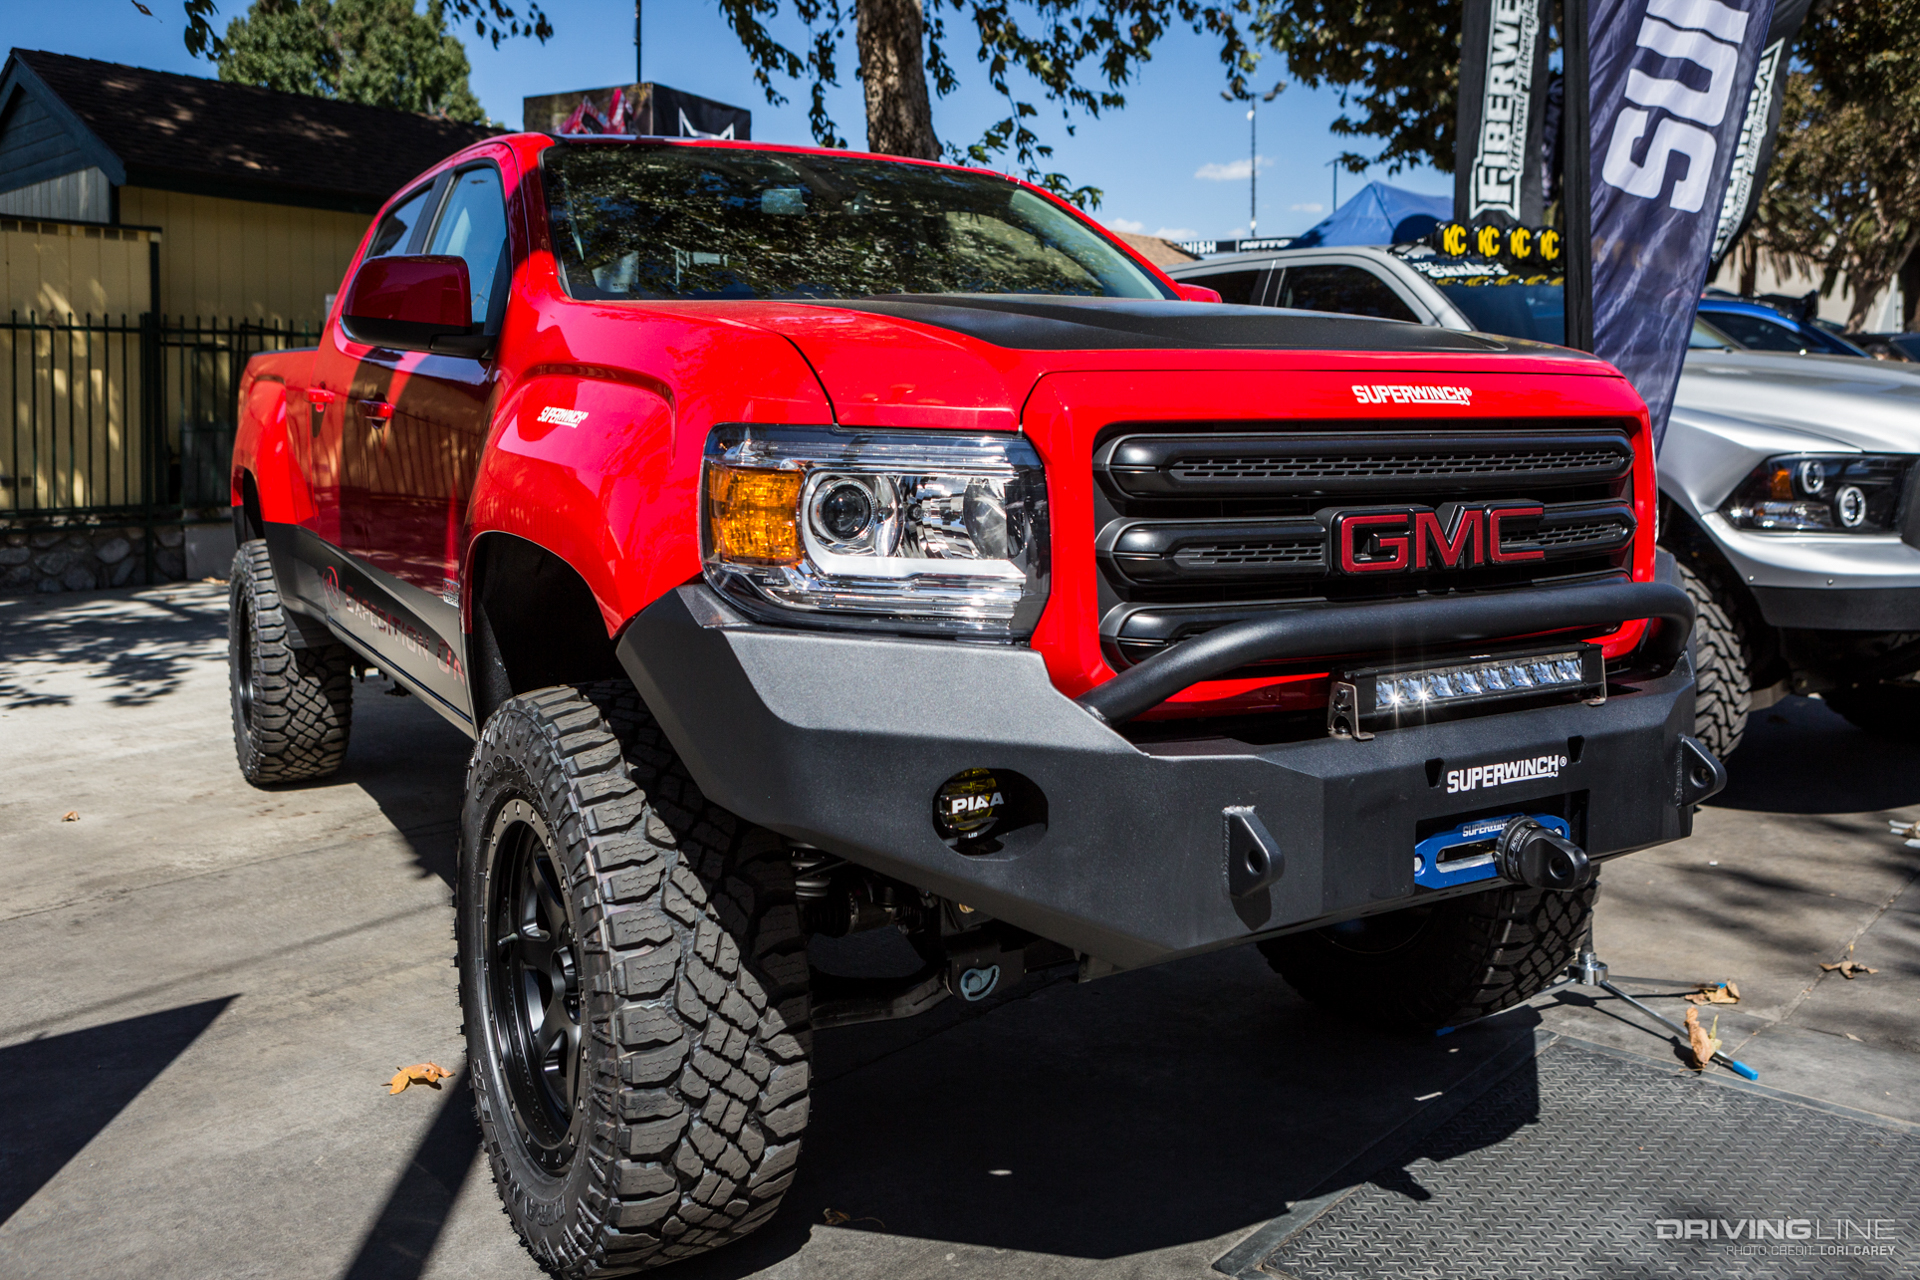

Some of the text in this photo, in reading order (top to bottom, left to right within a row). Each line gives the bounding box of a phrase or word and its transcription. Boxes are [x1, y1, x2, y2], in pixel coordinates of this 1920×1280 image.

[1181, 240, 1217, 254] NISH
[1443, 223, 1467, 256] KC
[1477, 225, 1500, 258] KC
[1510, 227, 1531, 259] KC
[1540, 229, 1560, 261] KC
[1341, 506, 1545, 573] GMC
[345, 584, 430, 662] EXPEDITION
[951, 791, 1005, 815] PIAA
[967, 831, 979, 839] LED
